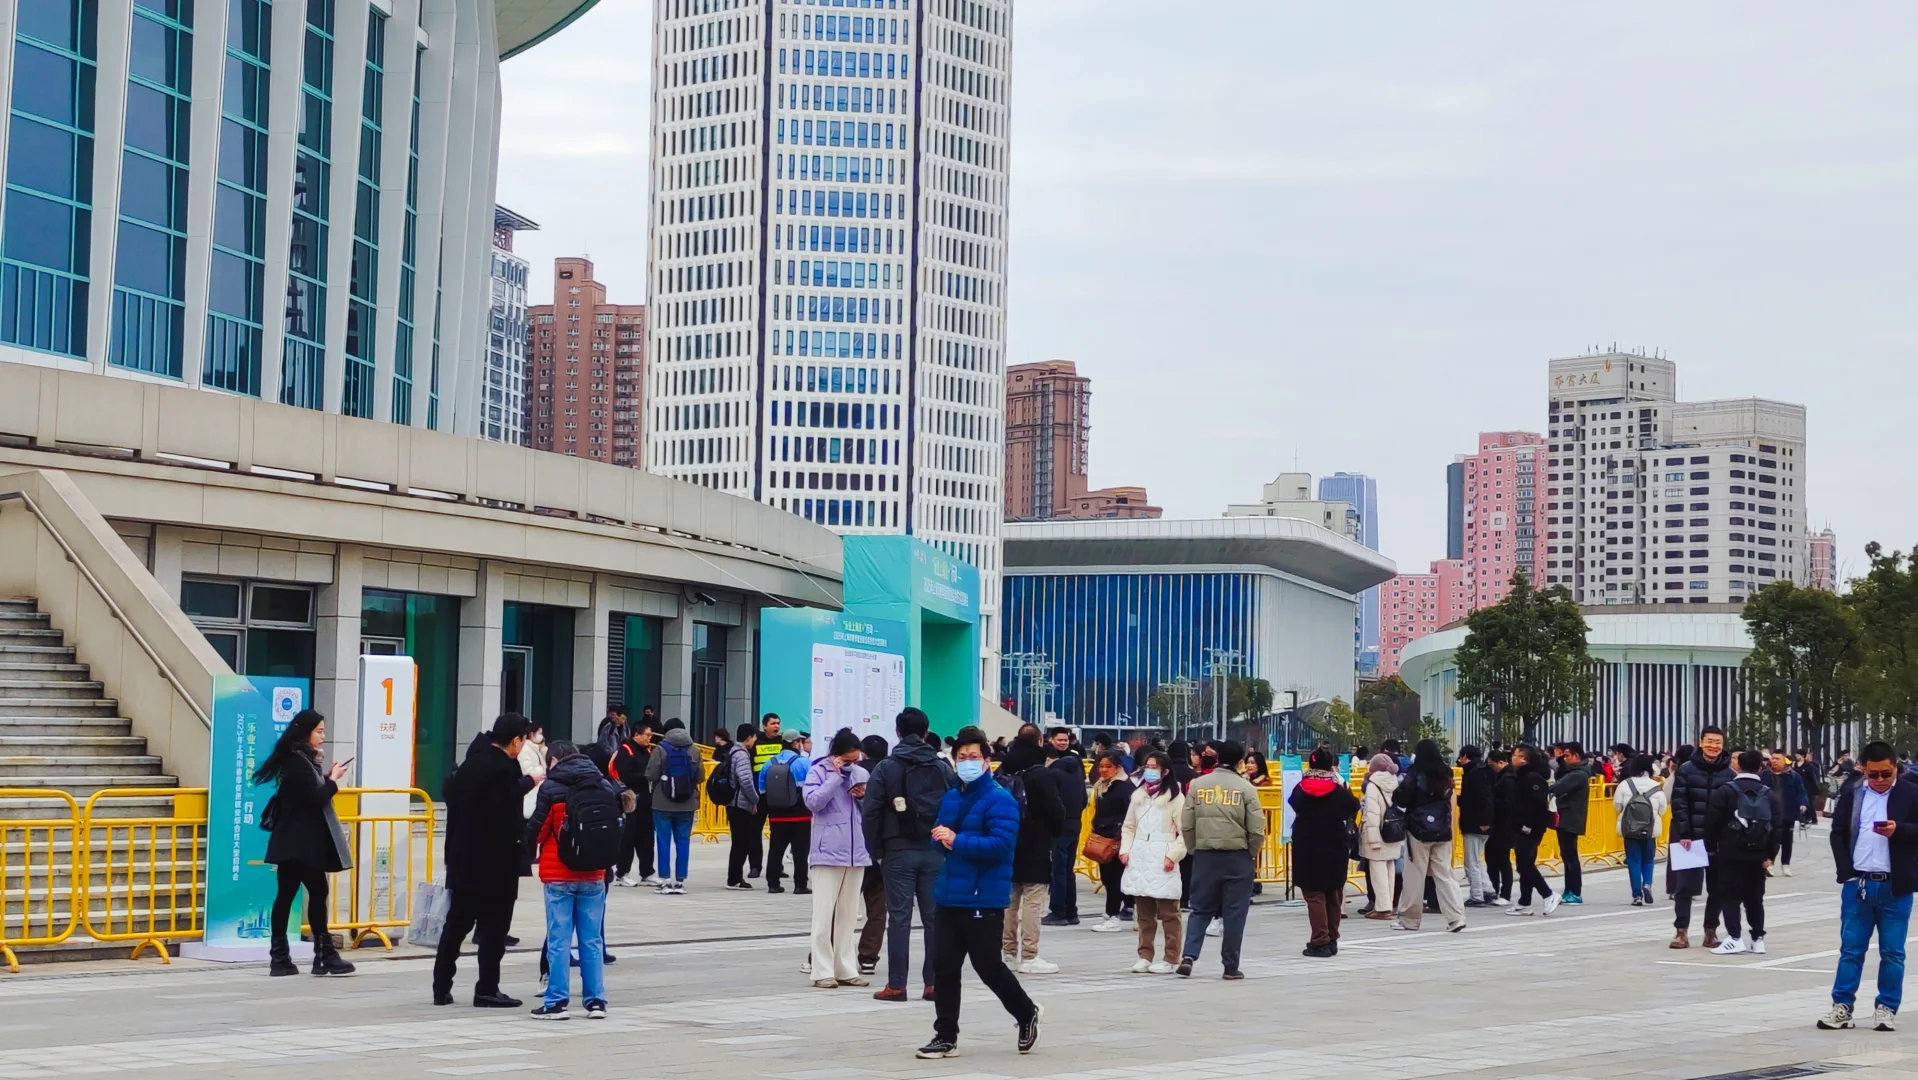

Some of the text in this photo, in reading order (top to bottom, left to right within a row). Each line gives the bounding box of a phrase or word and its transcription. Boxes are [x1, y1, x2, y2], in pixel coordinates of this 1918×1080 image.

[381, 677, 393, 715] 1
[380, 723, 396, 731] 扶梯
[1196, 788, 1241, 806] POLO
